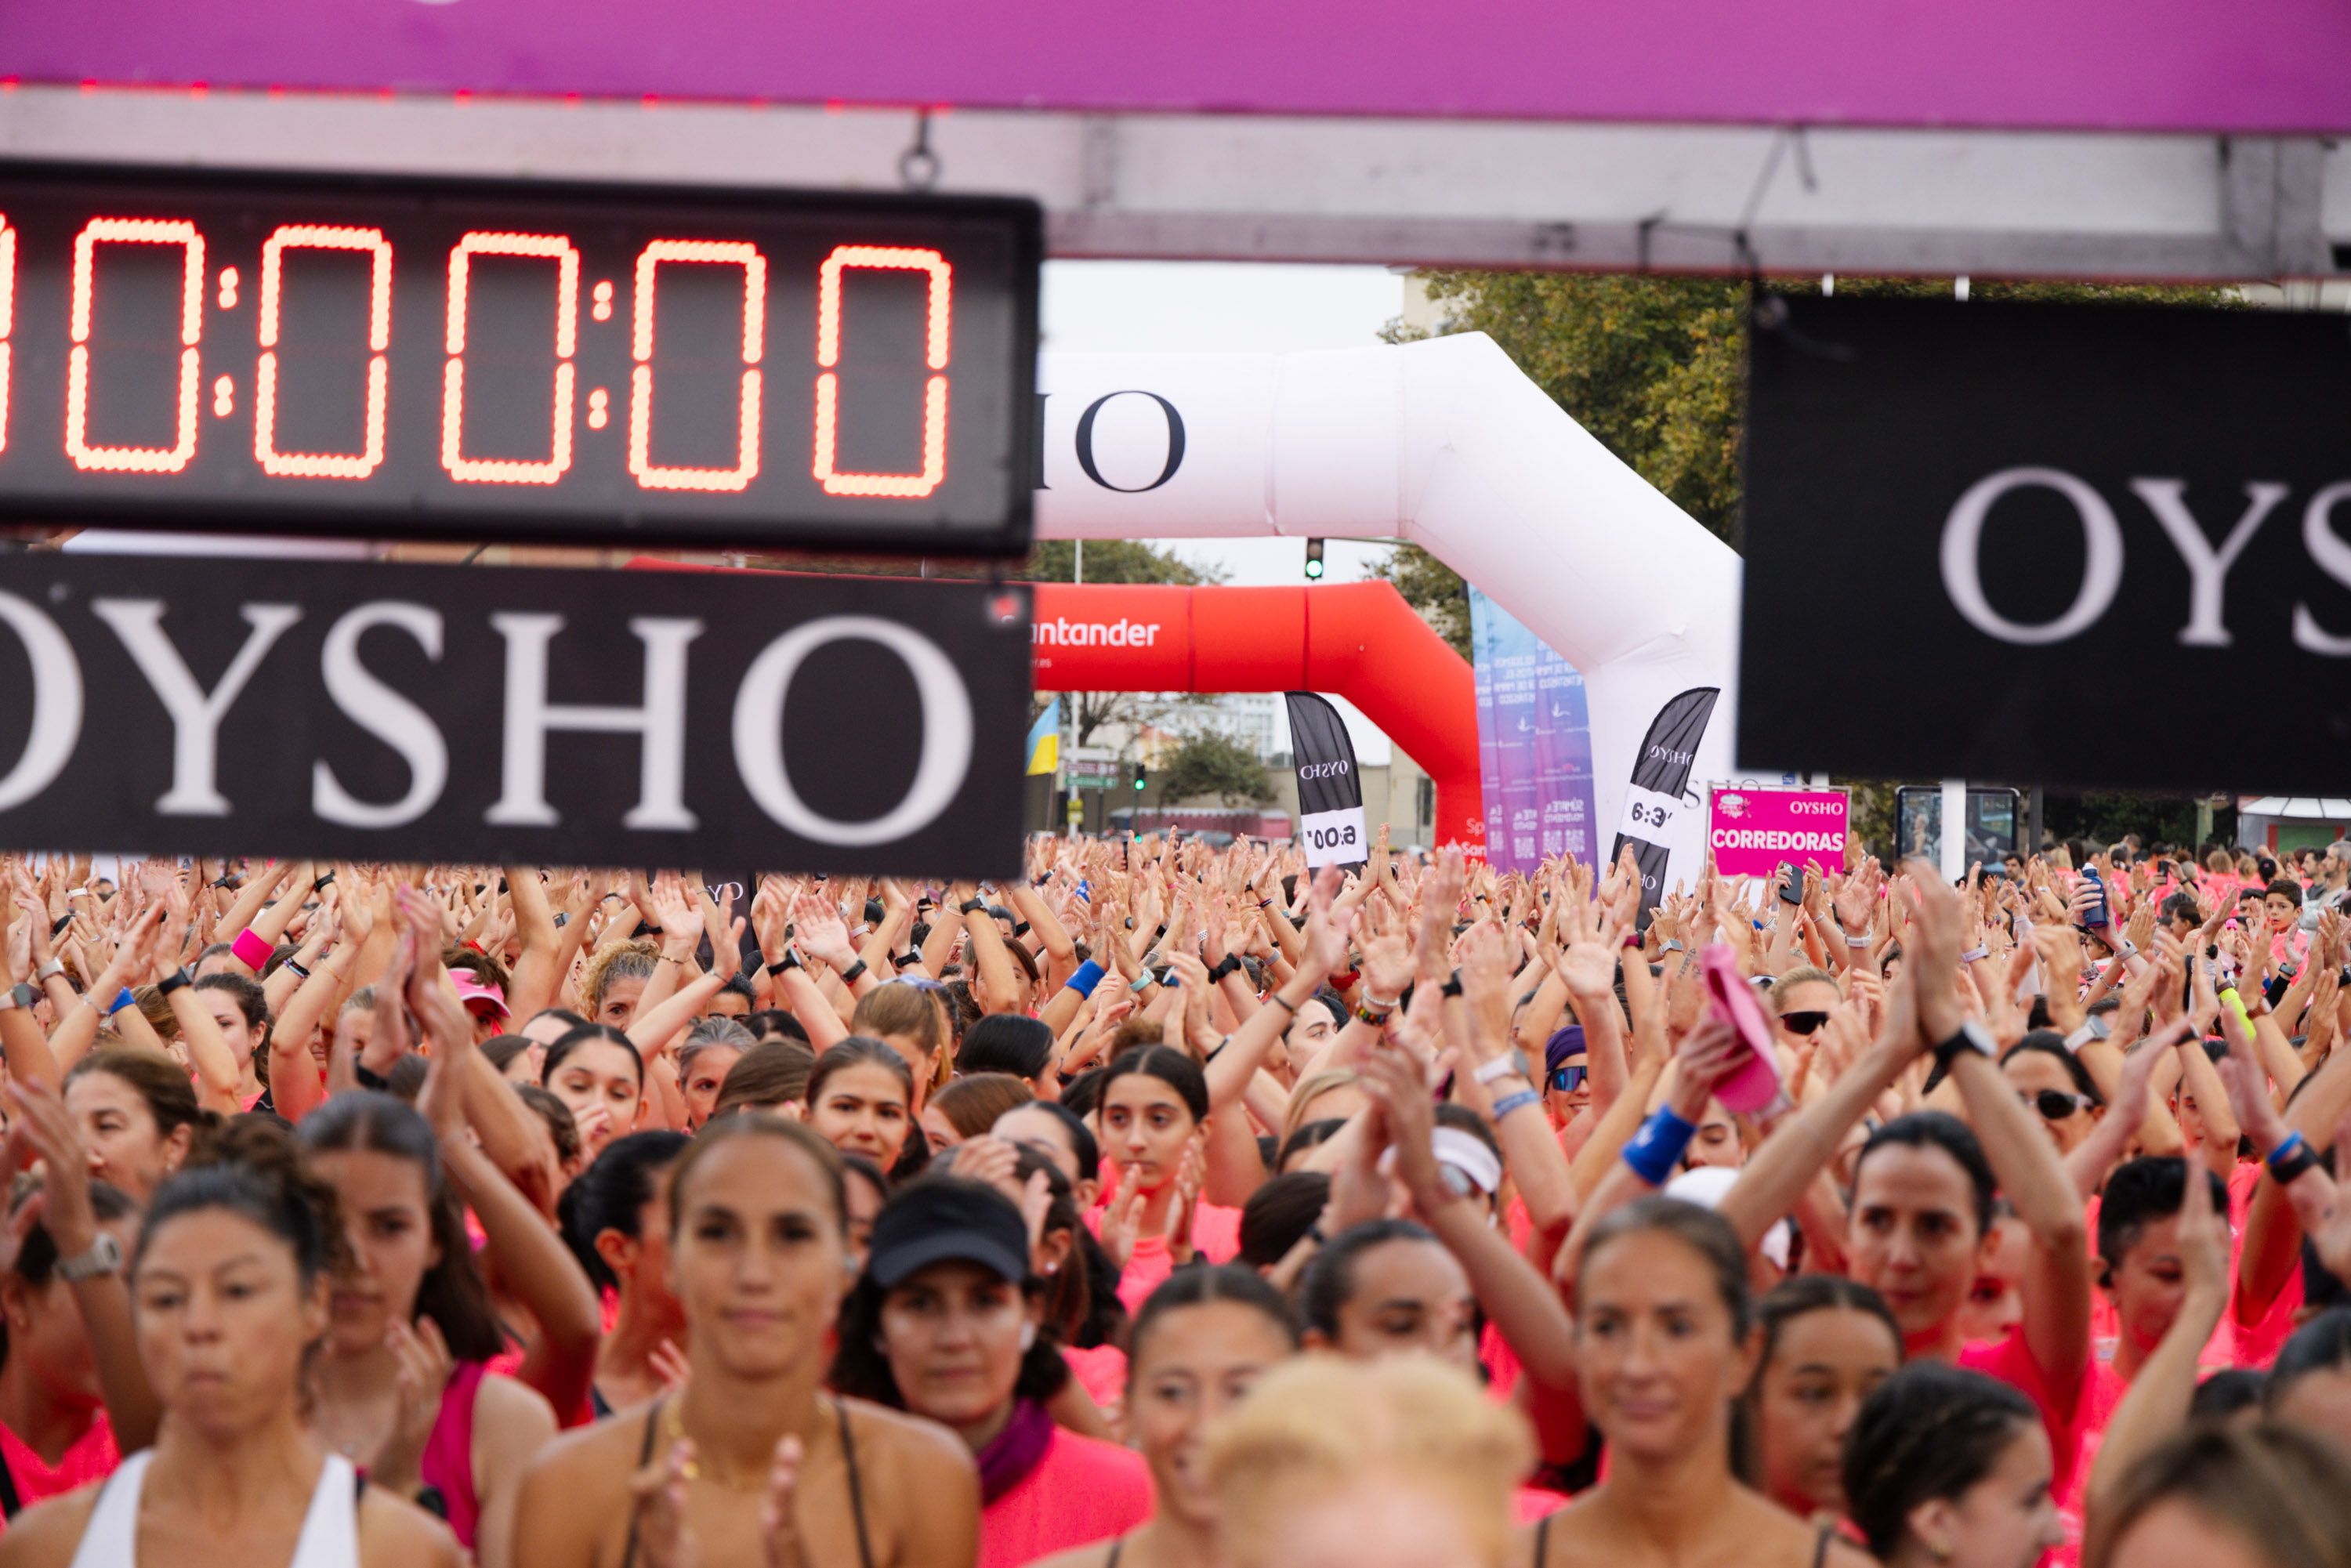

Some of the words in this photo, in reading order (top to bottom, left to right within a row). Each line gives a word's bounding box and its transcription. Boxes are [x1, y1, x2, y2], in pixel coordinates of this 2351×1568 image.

[0, 213, 951, 495] 0:00:00
[1790, 801, 1843, 816] OYSHO
[1712, 828, 1844, 852] CORREDORAS
